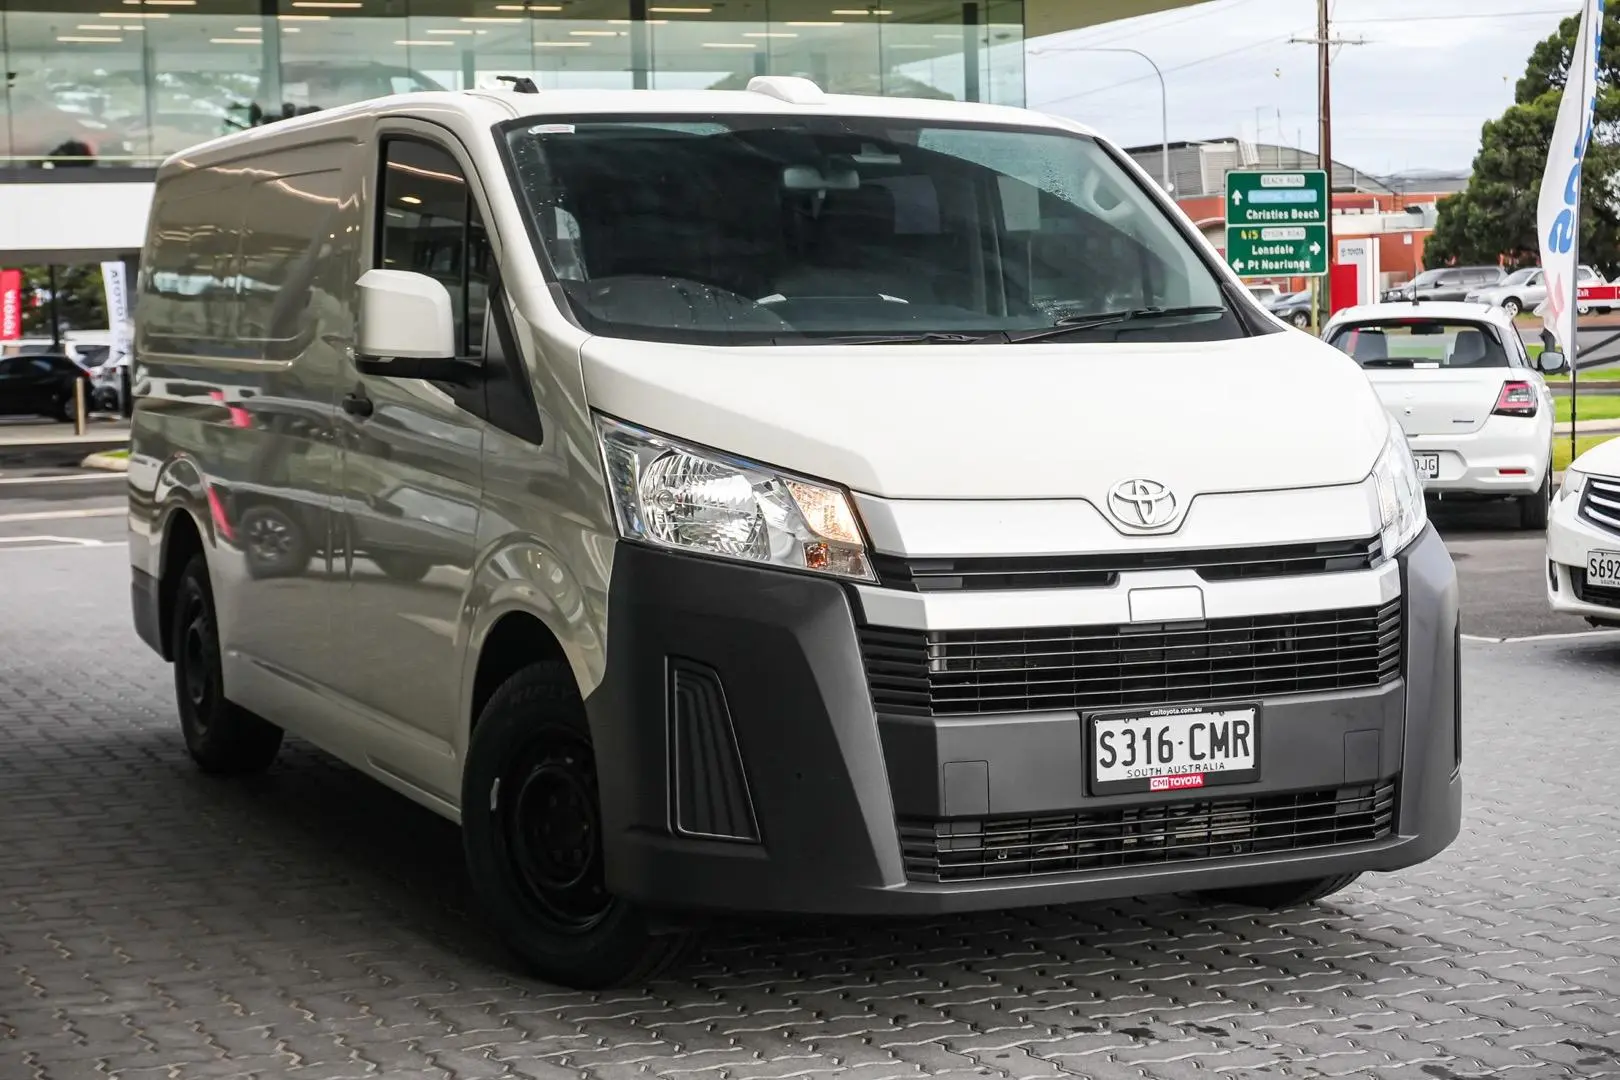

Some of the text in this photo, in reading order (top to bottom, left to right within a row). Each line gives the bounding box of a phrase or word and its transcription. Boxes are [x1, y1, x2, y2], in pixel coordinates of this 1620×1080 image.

[1246, 208, 1320, 220] Christies Beach
[1252, 244, 1294, 255] Lonsdale
[1247, 259, 1310, 271] Pt Noarlunga
[1150, 707, 1203, 716] cmitoyota.com.au
[1127, 763, 1226, 778] SOUTH AUSTRALIA
[1170, 776, 1202, 787] TOYOTA
